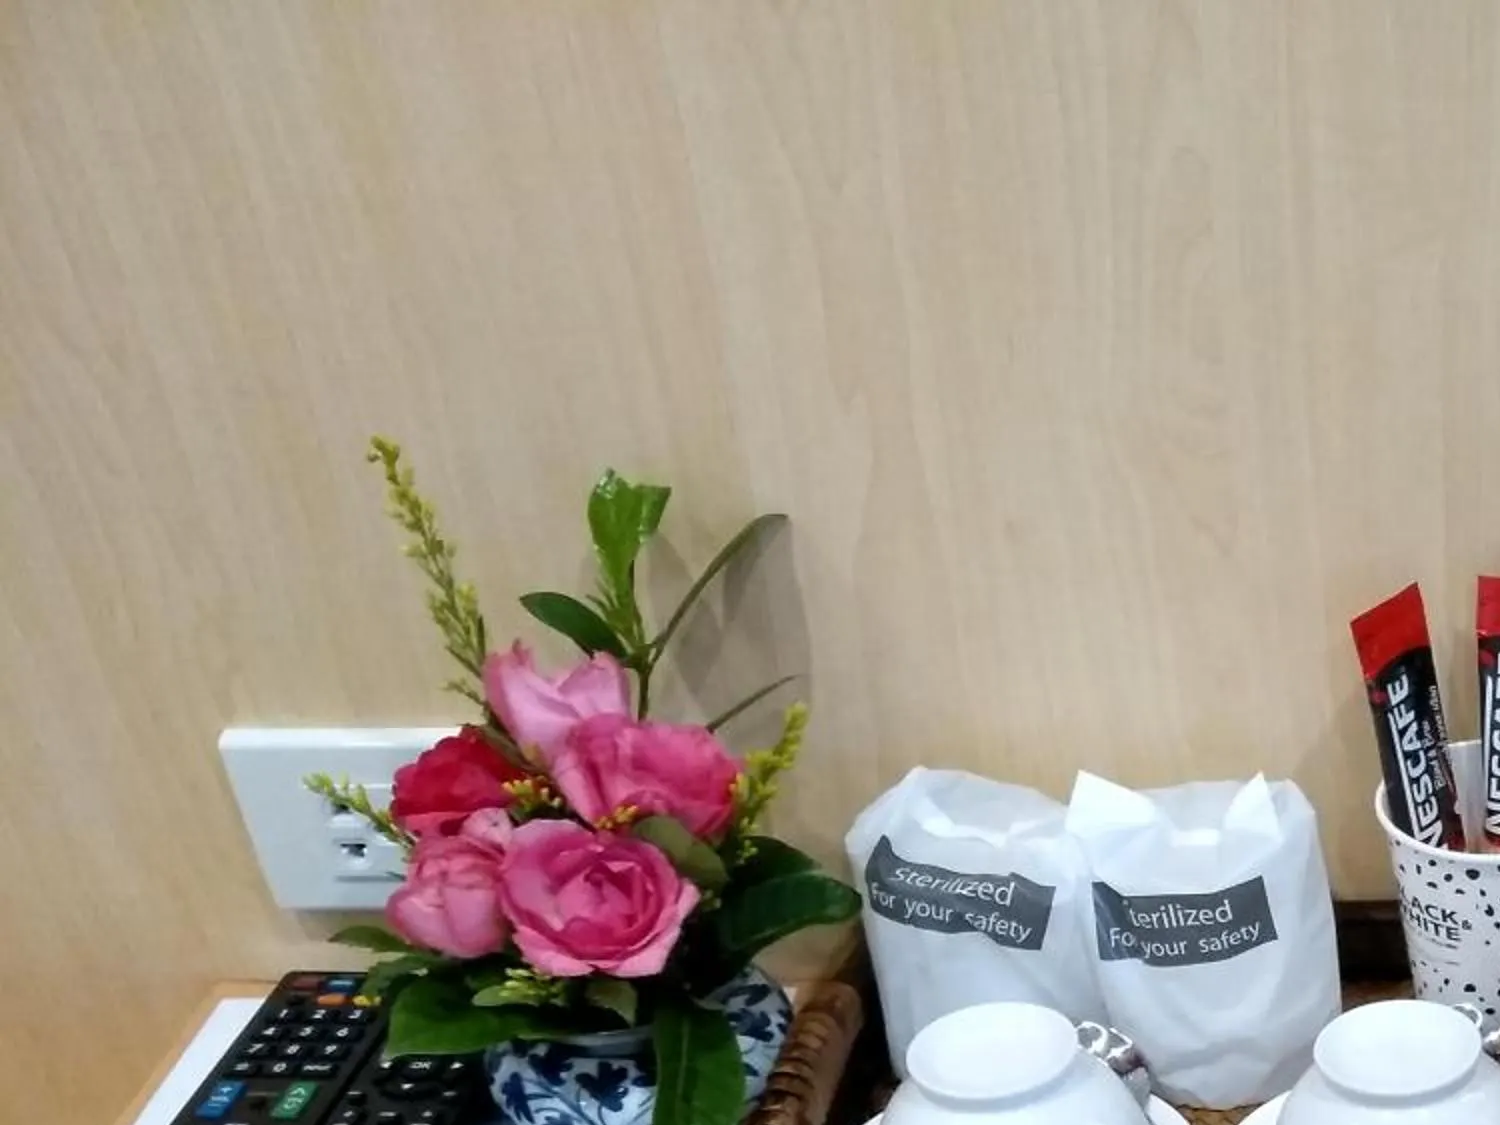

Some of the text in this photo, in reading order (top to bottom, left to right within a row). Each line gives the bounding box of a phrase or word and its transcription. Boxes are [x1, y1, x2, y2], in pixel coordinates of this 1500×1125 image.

[904, 897, 954, 923] your
[965, 911, 1033, 944] safety
[1123, 899, 1233, 930] terilized
[1141, 938, 1188, 959] your
[1198, 921, 1260, 954] safety
[279, 1008, 364, 1020] 1 2 3
